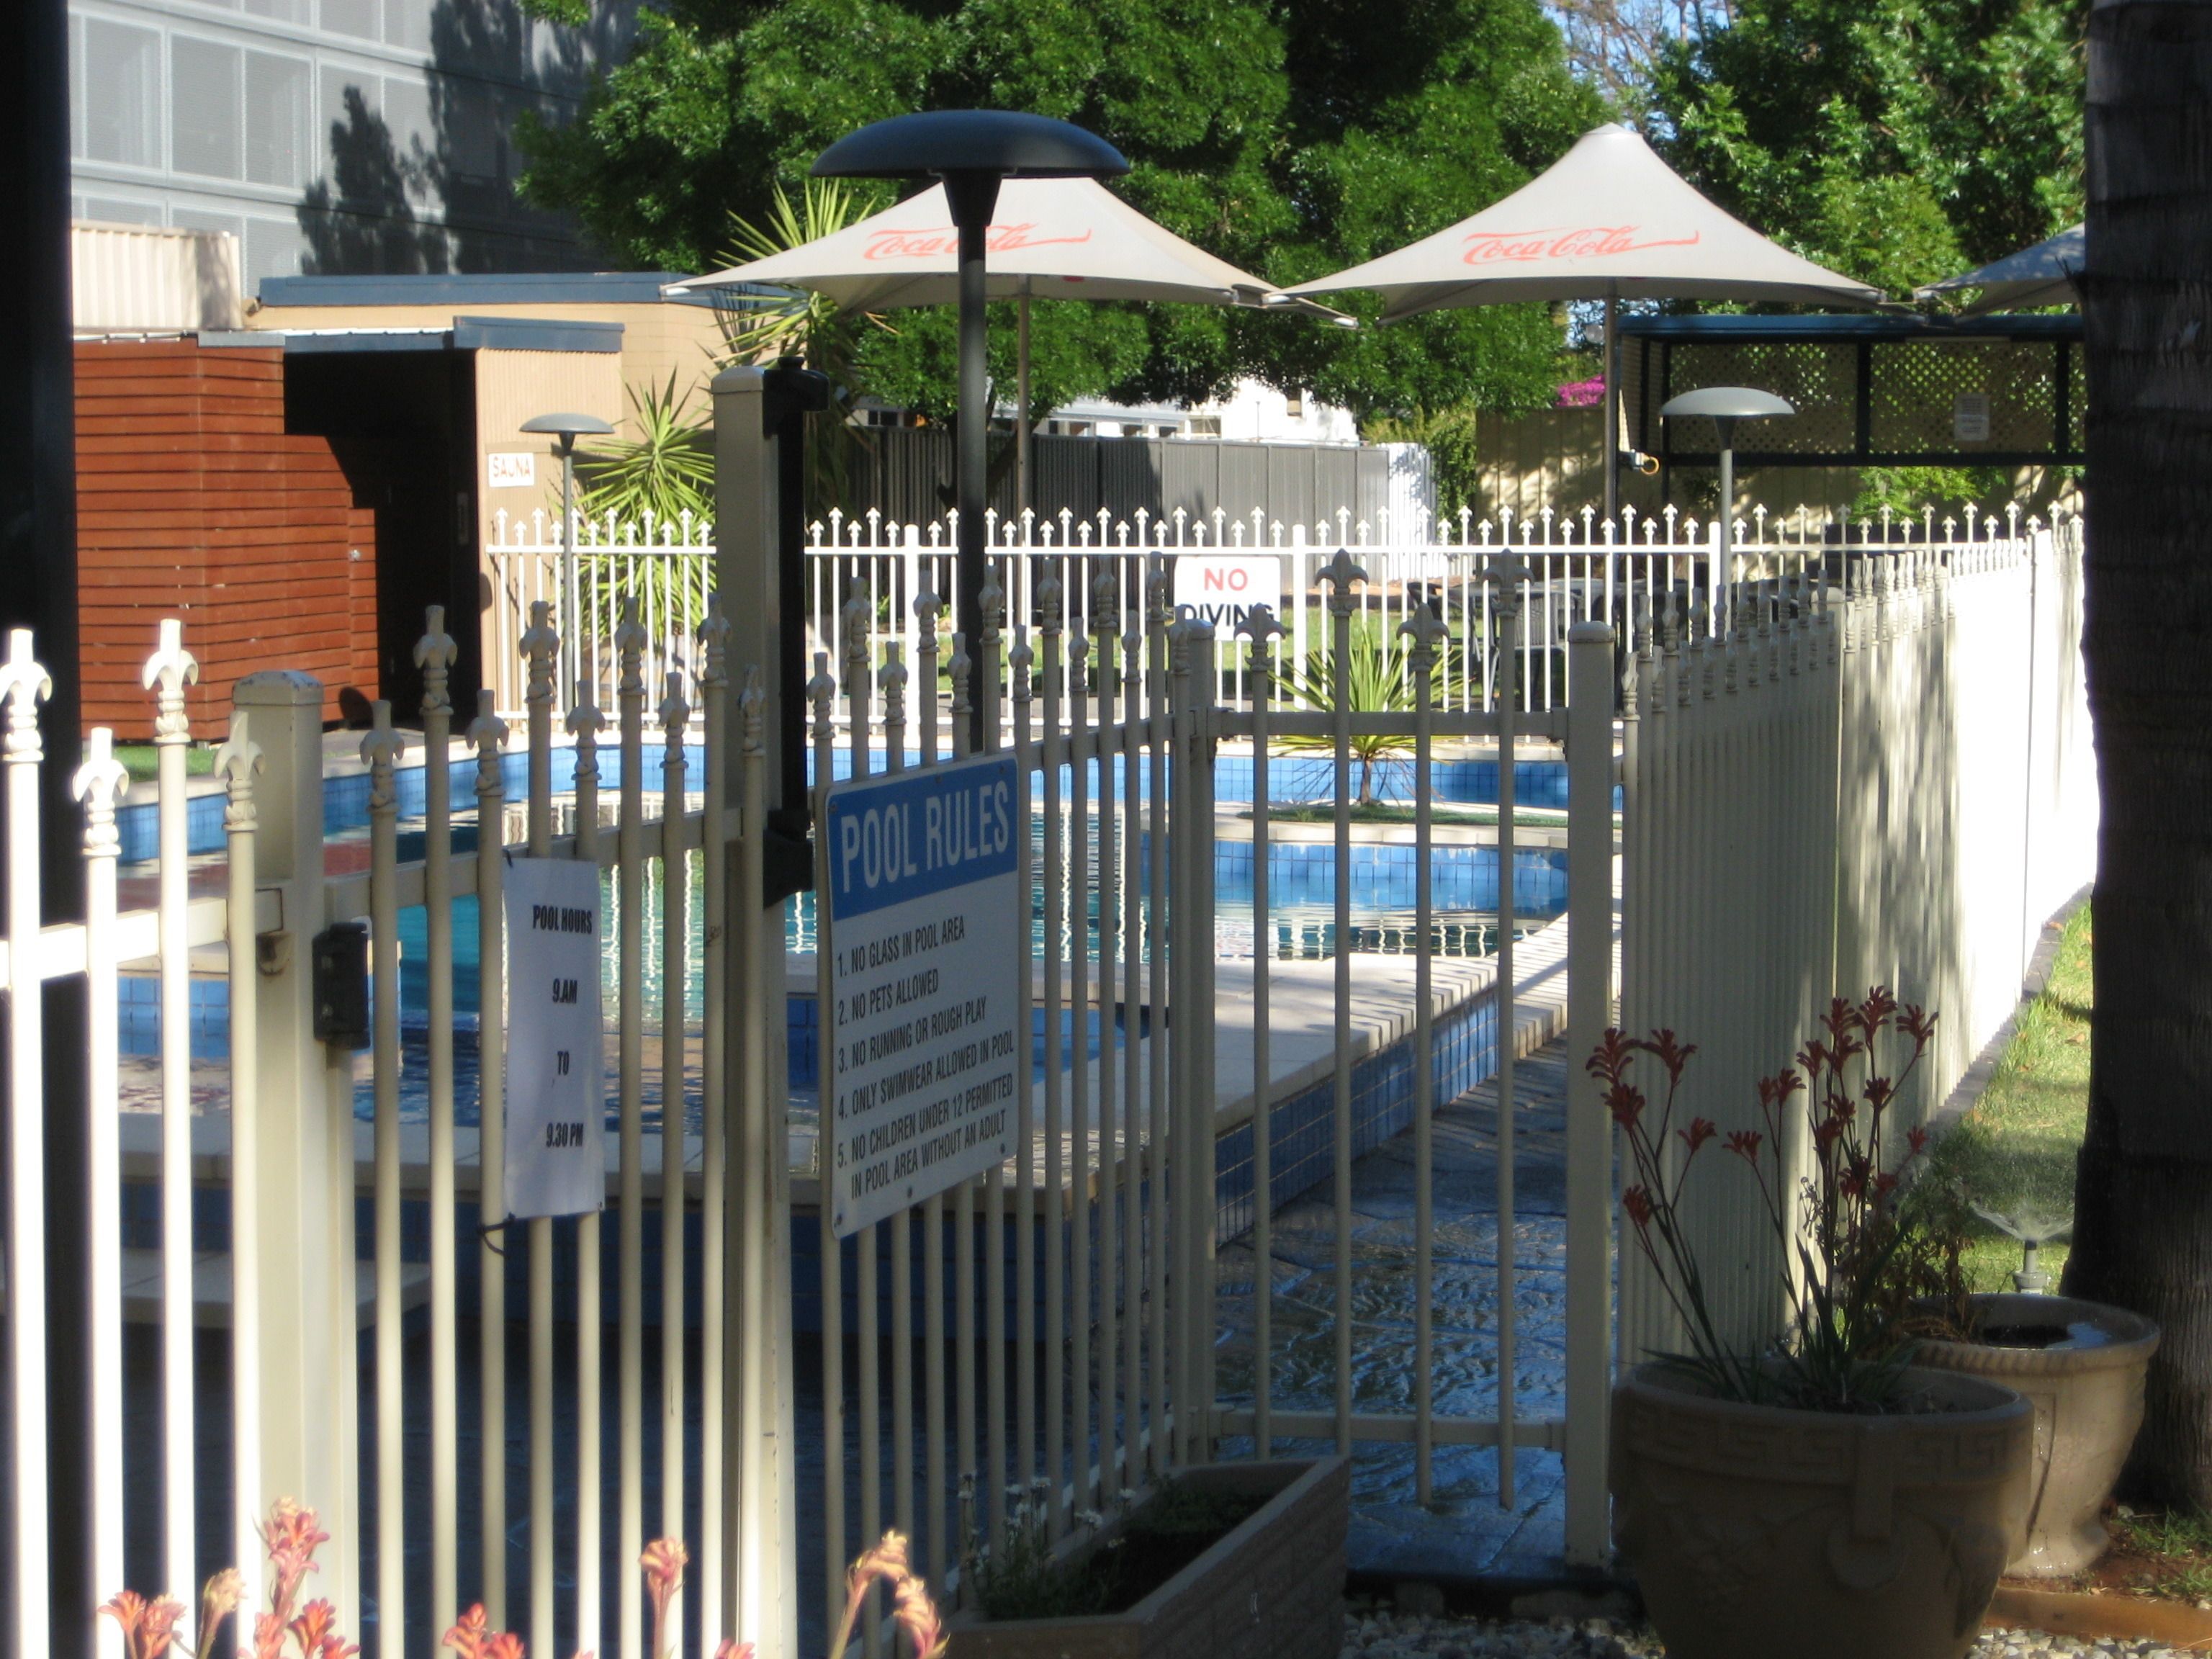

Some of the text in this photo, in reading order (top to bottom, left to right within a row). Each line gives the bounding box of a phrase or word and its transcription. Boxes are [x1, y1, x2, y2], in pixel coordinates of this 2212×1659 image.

[493, 455, 531, 477] SAUNA
[1204, 567, 1248, 591] NO
[840, 780, 1009, 893] POOL RULES
[532, 904, 593, 935] POOL HOURS
[837, 914, 966, 978] 1. NO GLASS IN POOL AREA
[838, 968, 939, 1026] 2. NO PETS ALLOWED
[557, 1050, 570, 1076] TO
[838, 995, 986, 1074] 3. NO RUNNING OR ROUGH PLAY
[838, 1030, 1014, 1120] 4. ONLY SWIMWEAR ALLOWED IN POOL
[546, 1121, 584, 1148] 9.30 PM
[837, 1072, 1013, 1169] 5. NO CHILDREN UNDER 12 PERMITTED
[852, 1107, 1006, 1200] IN POOL AREA WITHOUT AN ADULT
